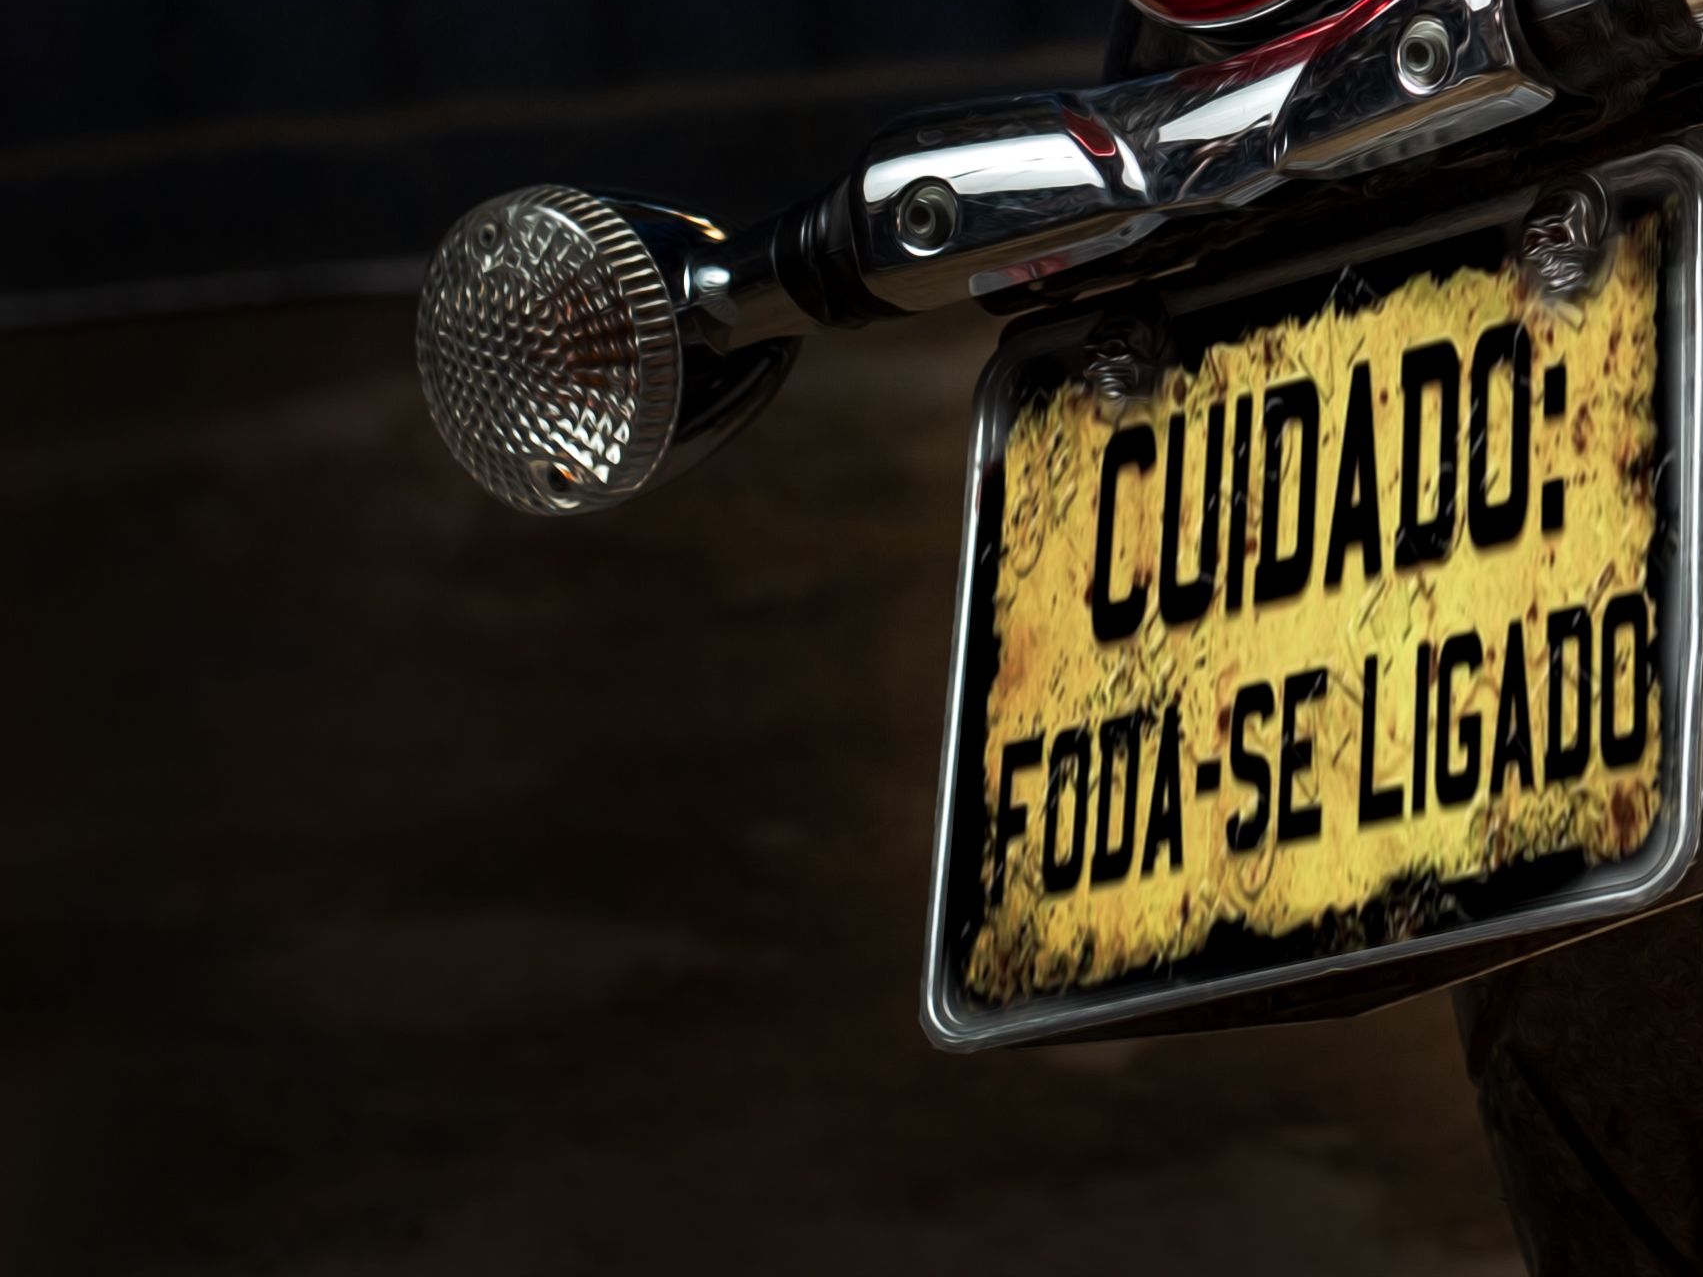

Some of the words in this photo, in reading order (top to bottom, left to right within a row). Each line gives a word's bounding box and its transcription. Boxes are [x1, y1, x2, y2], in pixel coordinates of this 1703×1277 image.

[1092, 322, 1566, 642] CUIDADO:
[994, 670, 1328, 897] FODA-SE
[1358, 595, 1649, 823] LIGADO
